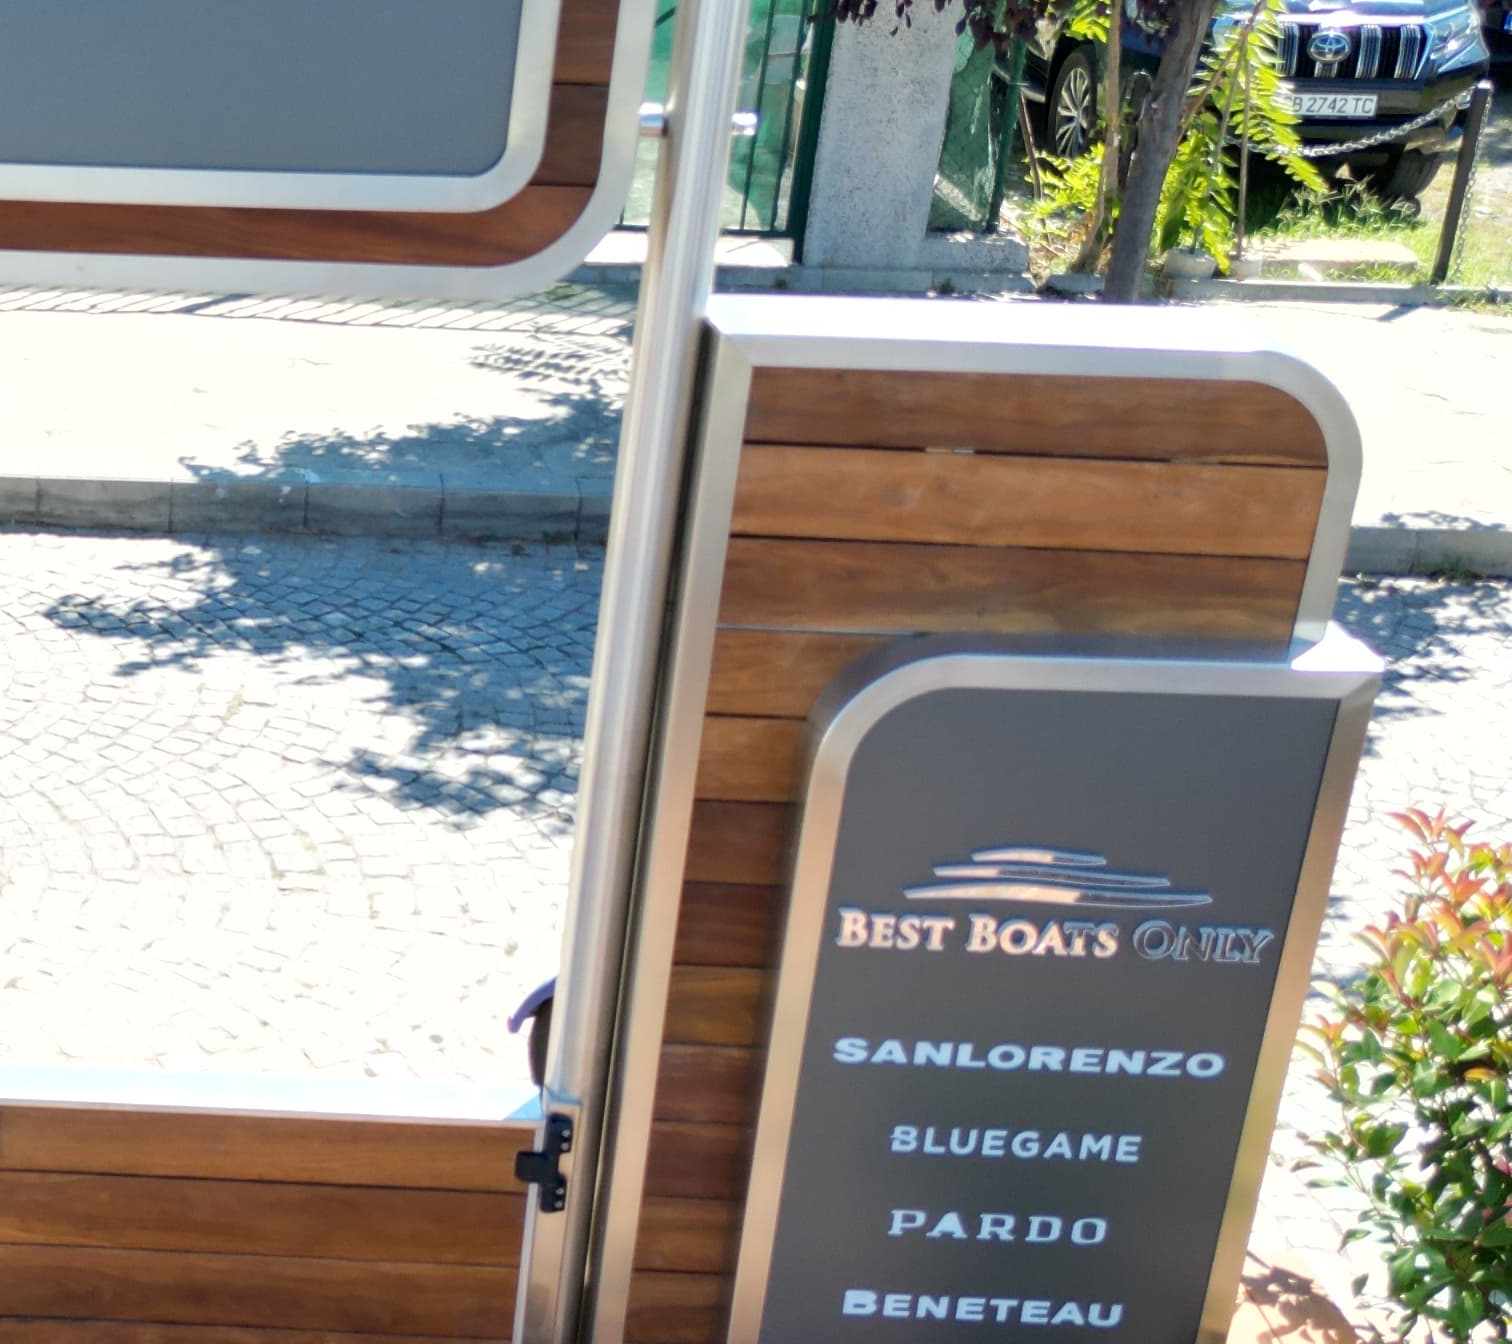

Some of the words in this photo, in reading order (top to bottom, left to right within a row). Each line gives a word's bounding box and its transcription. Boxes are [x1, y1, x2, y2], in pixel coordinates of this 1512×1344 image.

[1306, 97, 1348, 113] 2742
[1353, 98, 1374, 114] TC
[836, 905, 956, 951] BEST
[965, 912, 1119, 958] BOATS
[1132, 918, 1276, 964] ONLY
[832, 1037, 1226, 1078] SANLORENZO
[890, 1125, 1143, 1163] BLUEGAME
[888, 1209, 1108, 1245] PARDO
[842, 1289, 1124, 1327] BENETEAU
